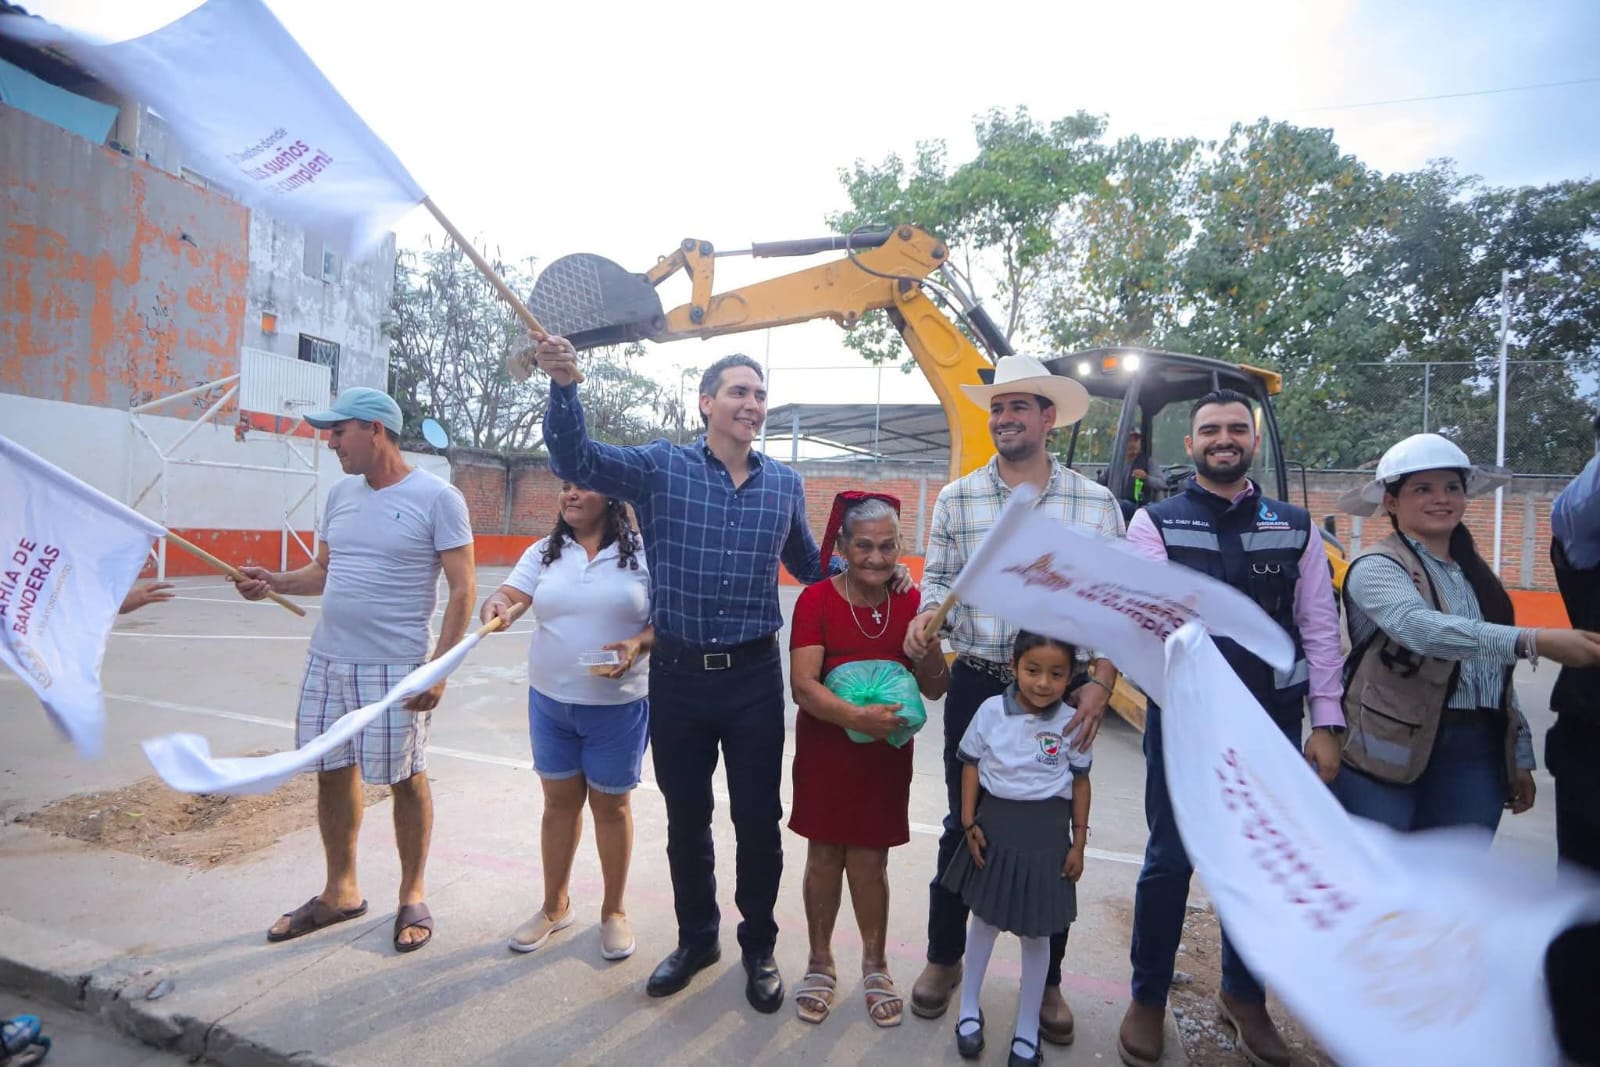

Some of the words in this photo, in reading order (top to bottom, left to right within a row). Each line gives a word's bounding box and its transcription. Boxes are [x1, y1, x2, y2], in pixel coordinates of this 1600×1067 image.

[263, 140, 310, 175] sueños
[0, 569, 21, 616] AHIA
[13, 537, 37, 566] DE
[13, 544, 60, 635] BANDERAS
